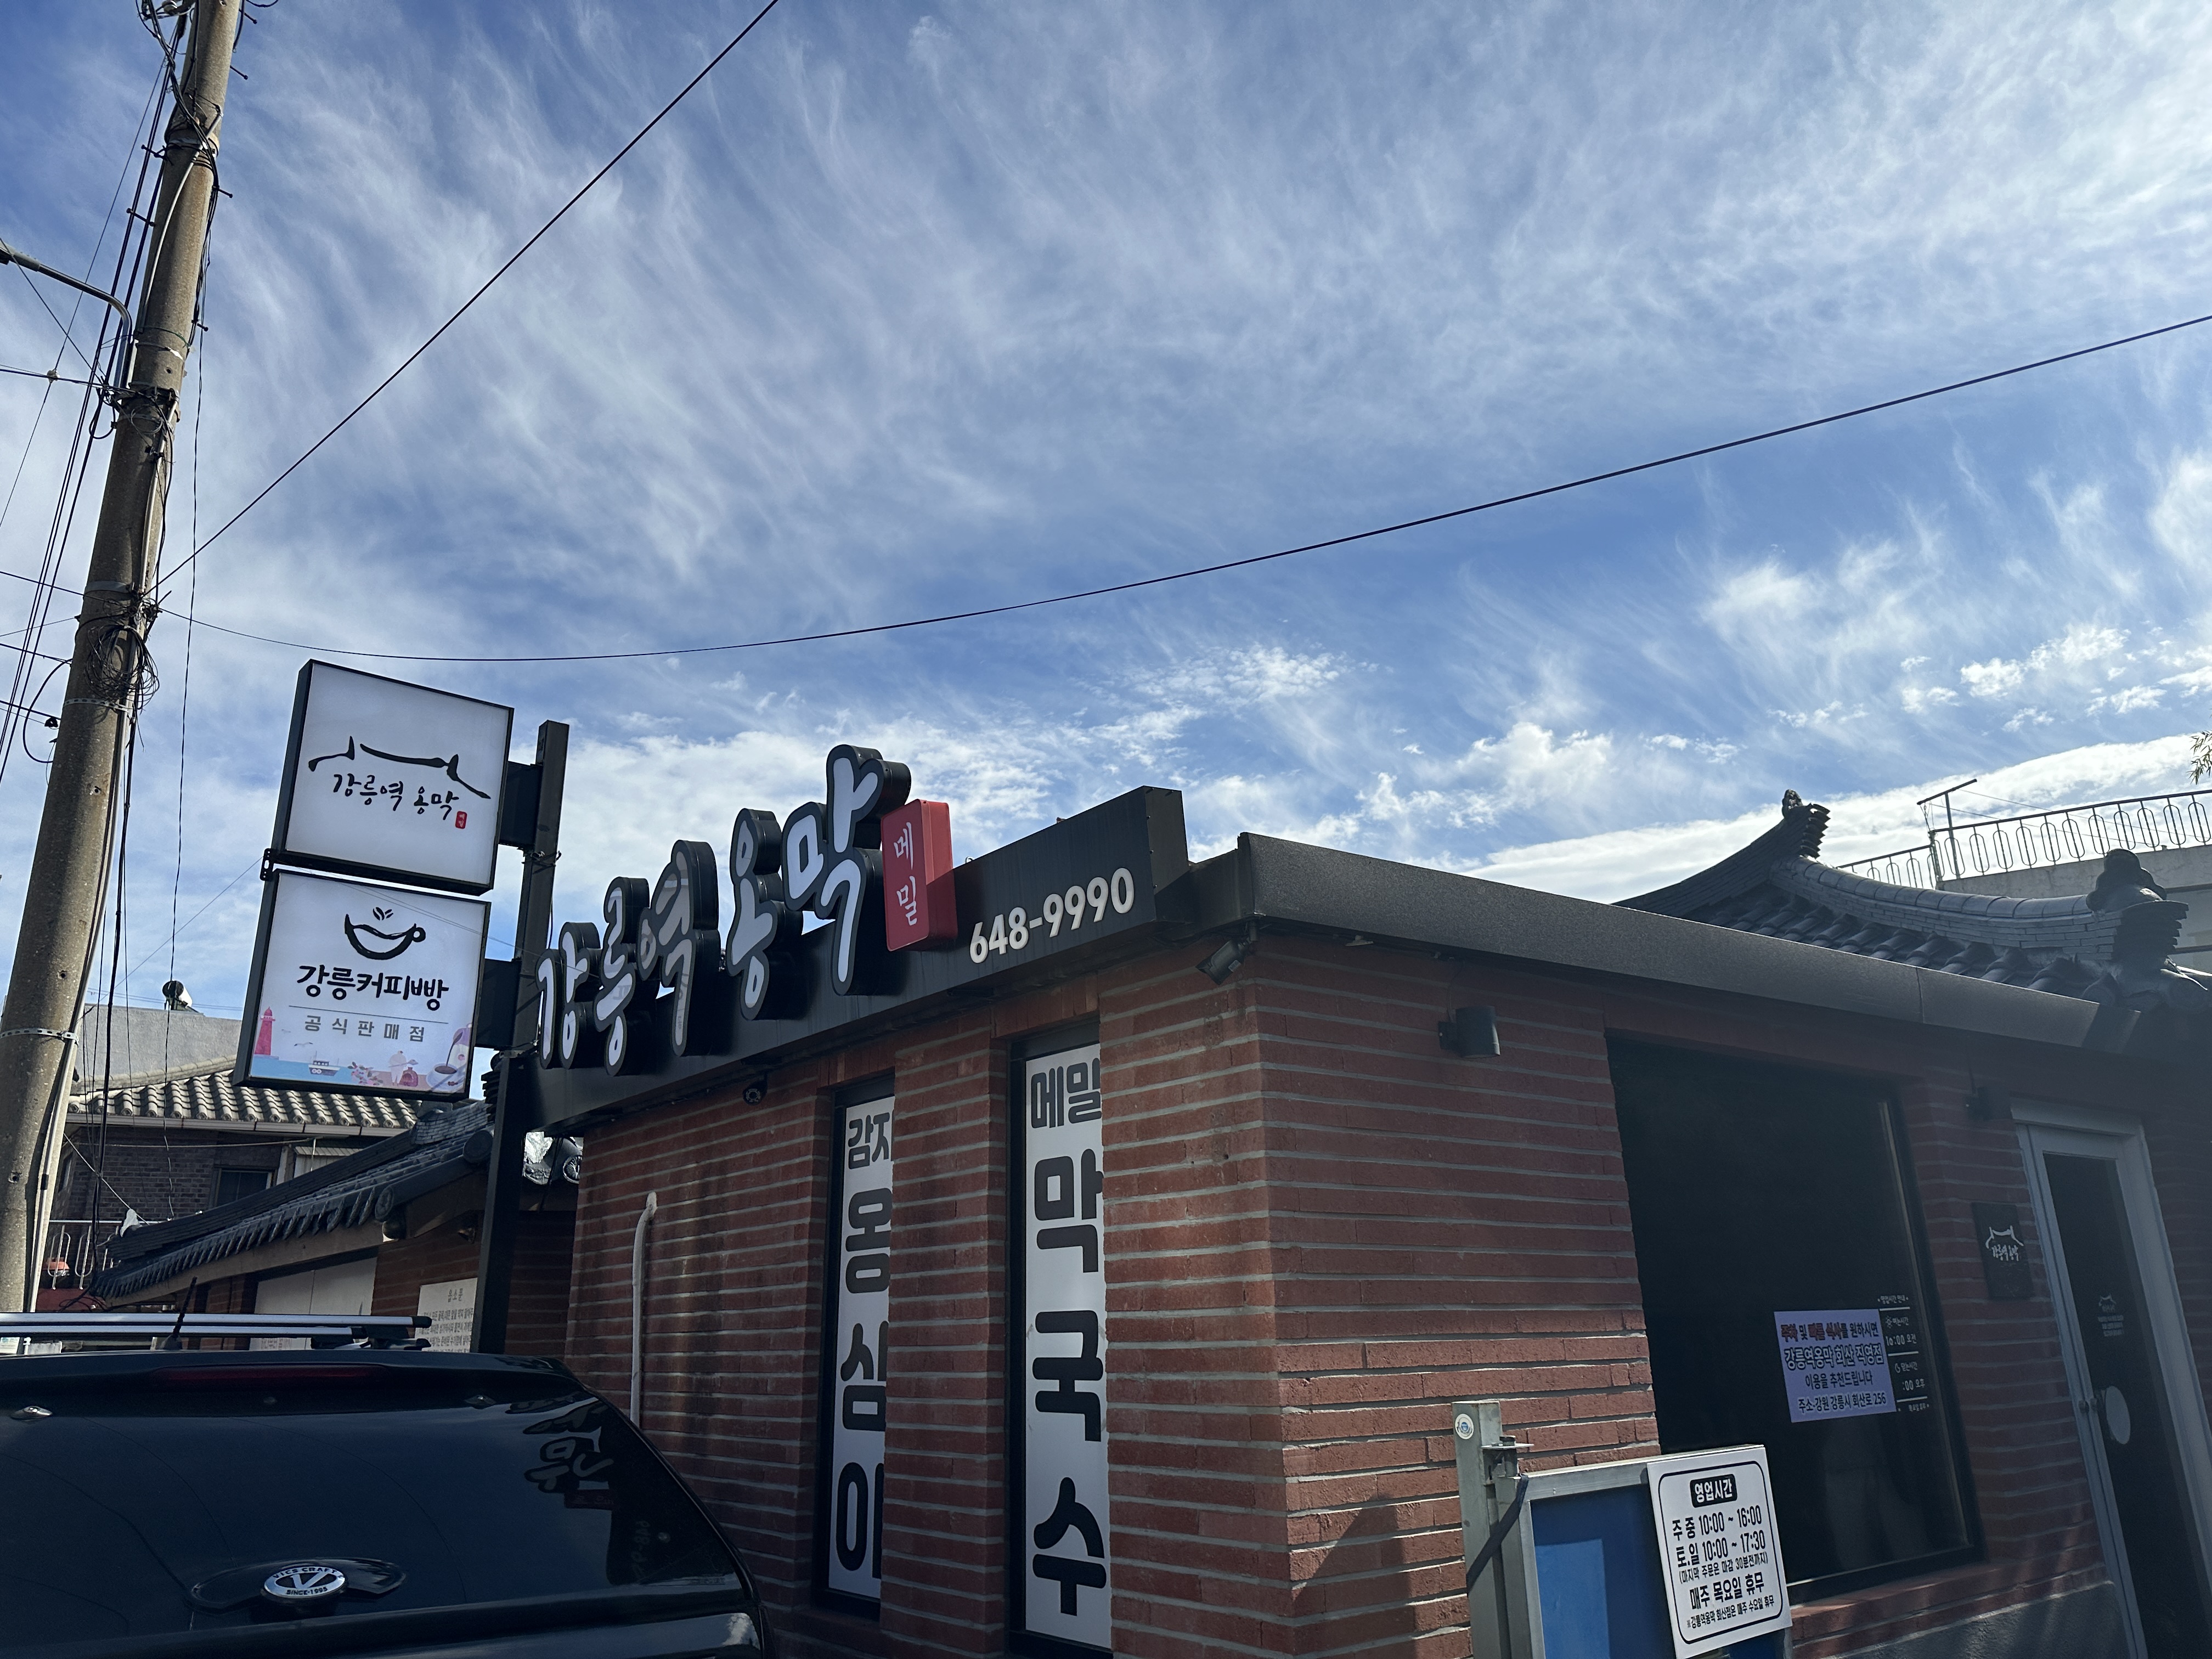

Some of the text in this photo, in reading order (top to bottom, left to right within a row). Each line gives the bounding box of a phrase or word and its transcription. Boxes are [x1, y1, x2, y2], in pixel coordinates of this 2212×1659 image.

[333, 773, 460, 821] 강릉역 옹막
[893, 821, 919, 927] 메밀
[969, 867, 1135, 963] 648-9990
[296, 964, 450, 1012] 강릉커피빵
[1799, 1324, 1808, 1340] 및
[1850, 1321, 1879, 1339] 원하시면
[1784, 1342, 1884, 1370] 강릉역옹막 회산 직영점
[1032, 1148, 1107, 1616] 막국수
[1805, 1370, 1873, 1390] 이용을 추천드립니다
[1831, 1394, 1852, 1410] 강릉시
[1852, 1393, 1873, 1408] 회산로
[1873, 1392, 1886, 1405] 256
[1694, 1478, 1733, 1503] 영업시간
[1699, 1511, 1724, 1536] 10:00
[1737, 1505, 1762, 1528] 16:00
[1702, 1537, 1729, 1562] 10:00
[1740, 1530, 1765, 1554] 17:30
[273, 1568, 298, 1579] VICS
[1679, 1566, 1700, 1584] (마지막
[1702, 1562, 1719, 1578] 주문은
[1722, 1558, 1734, 1573] 마감
[1690, 1572, 1764, 1610] 매주 목요일 휴무
[1749, 1598, 1763, 1612] 수요일
[1764, 1595, 1774, 1607] 휴무
